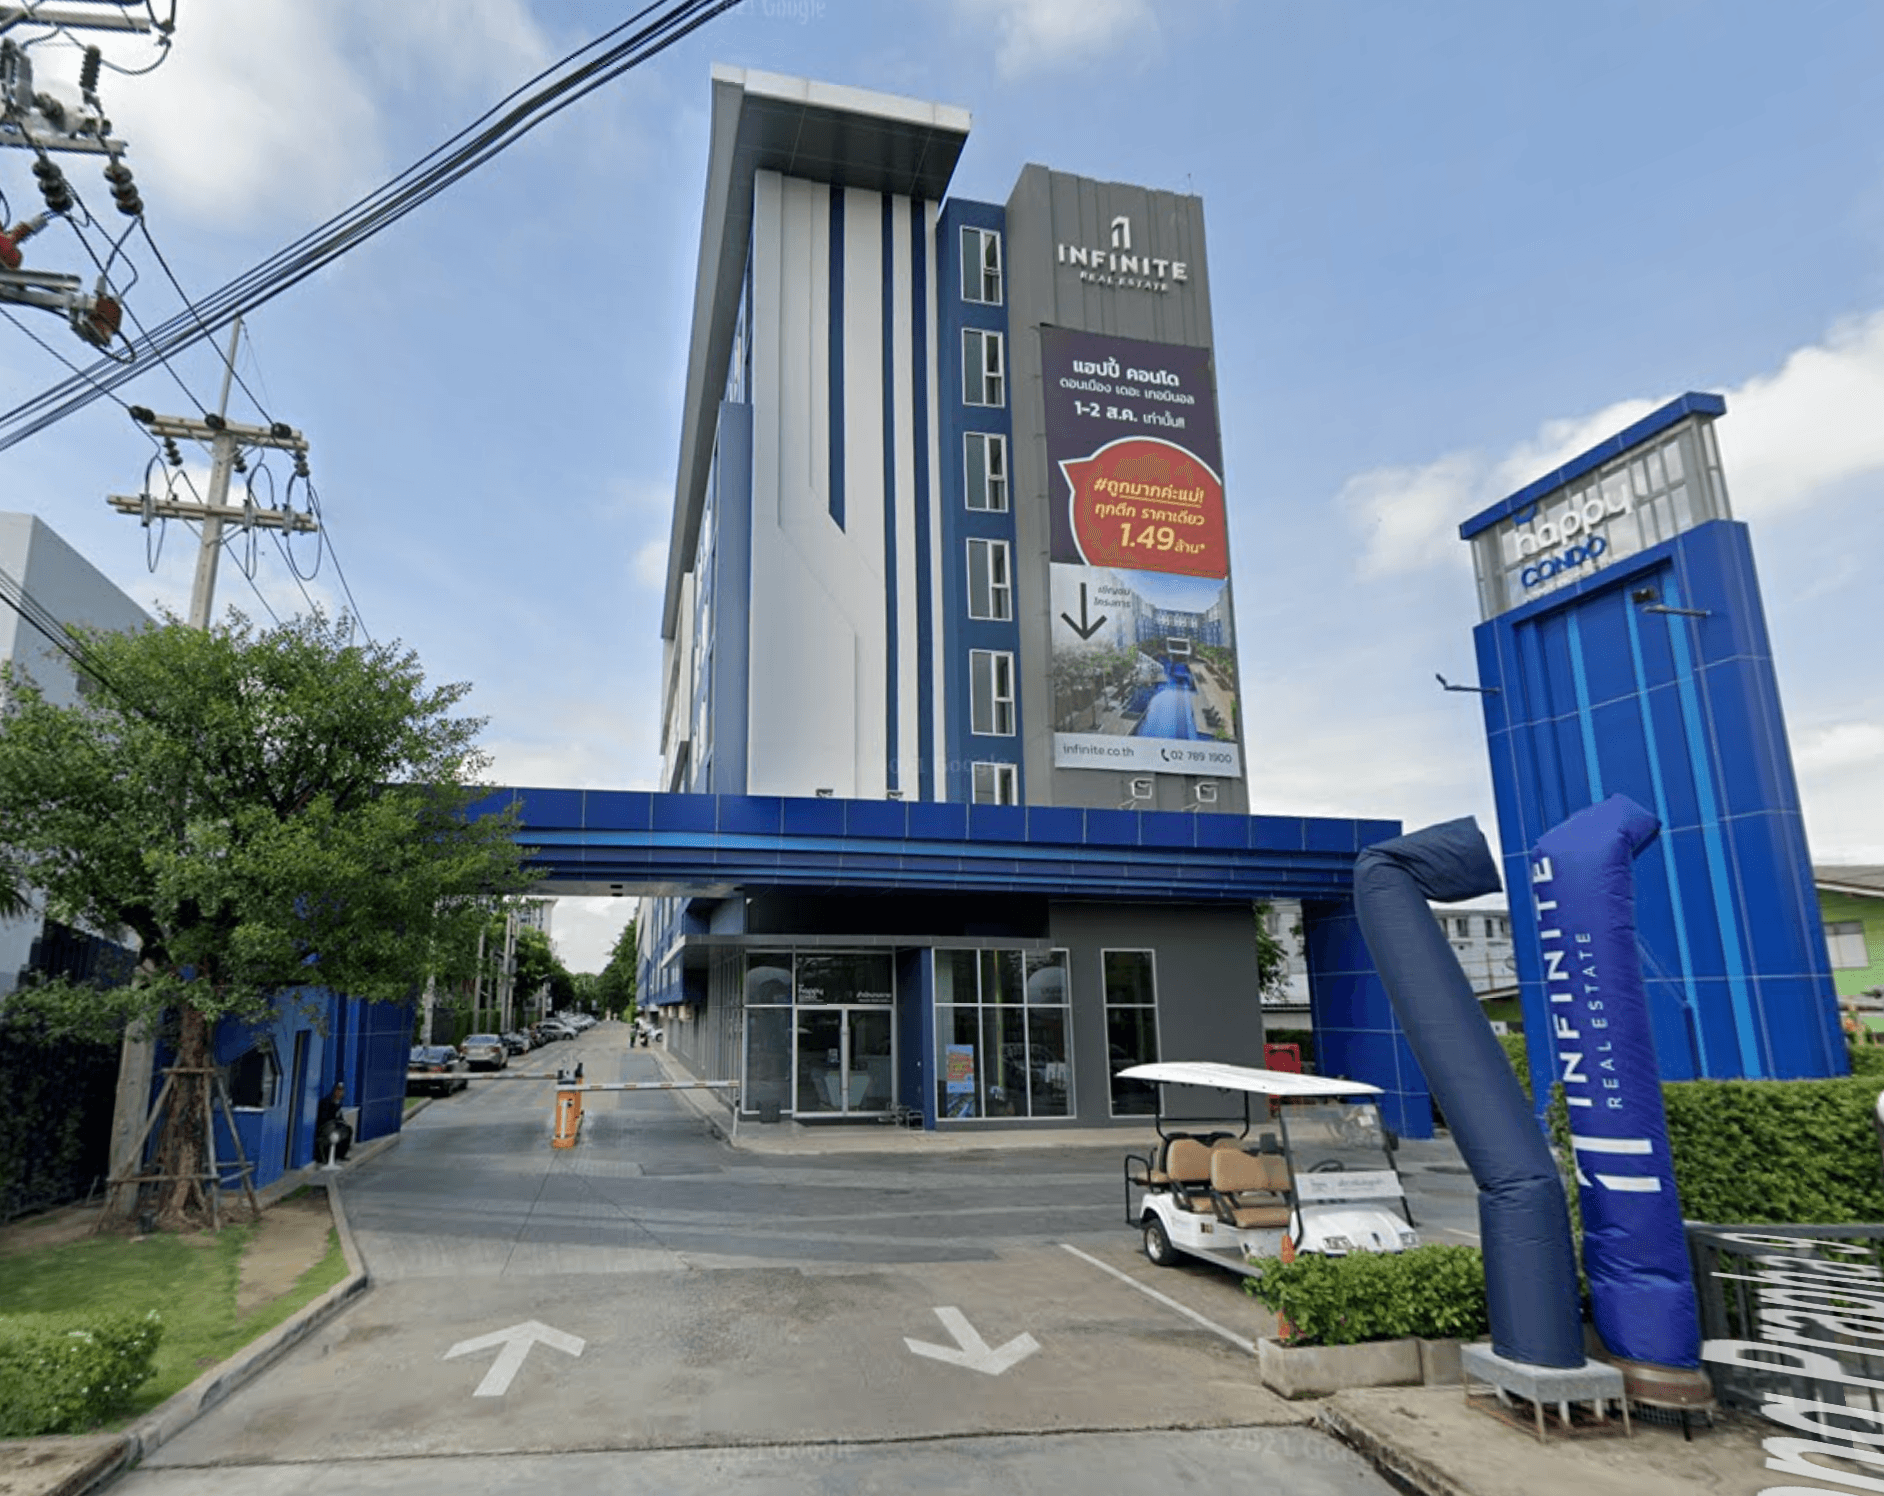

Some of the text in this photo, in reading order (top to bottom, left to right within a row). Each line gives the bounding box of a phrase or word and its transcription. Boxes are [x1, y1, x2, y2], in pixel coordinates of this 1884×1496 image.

[1057, 243, 1188, 282] INFINITE
[1080, 271, 1169, 292] REAL ESTATE
[1072, 356, 1180, 387] แฮปปี้ คอนโด
[1074, 400, 1100, 418] 1-2
[1106, 405, 1138, 423] ส.ค.
[1141, 507, 1205, 526] ราคาเดียว
[1514, 484, 1633, 558] happy
[1120, 522, 1175, 551] 1.49
[1521, 535, 1607, 589] CONDO
[1063, 743, 1135, 757] infinite.co.th
[1170, 750, 1232, 763] 02 789 1900
[1532, 856, 1593, 1107] INFINITE
[1574, 932, 1624, 1110] REAL ESTATE
